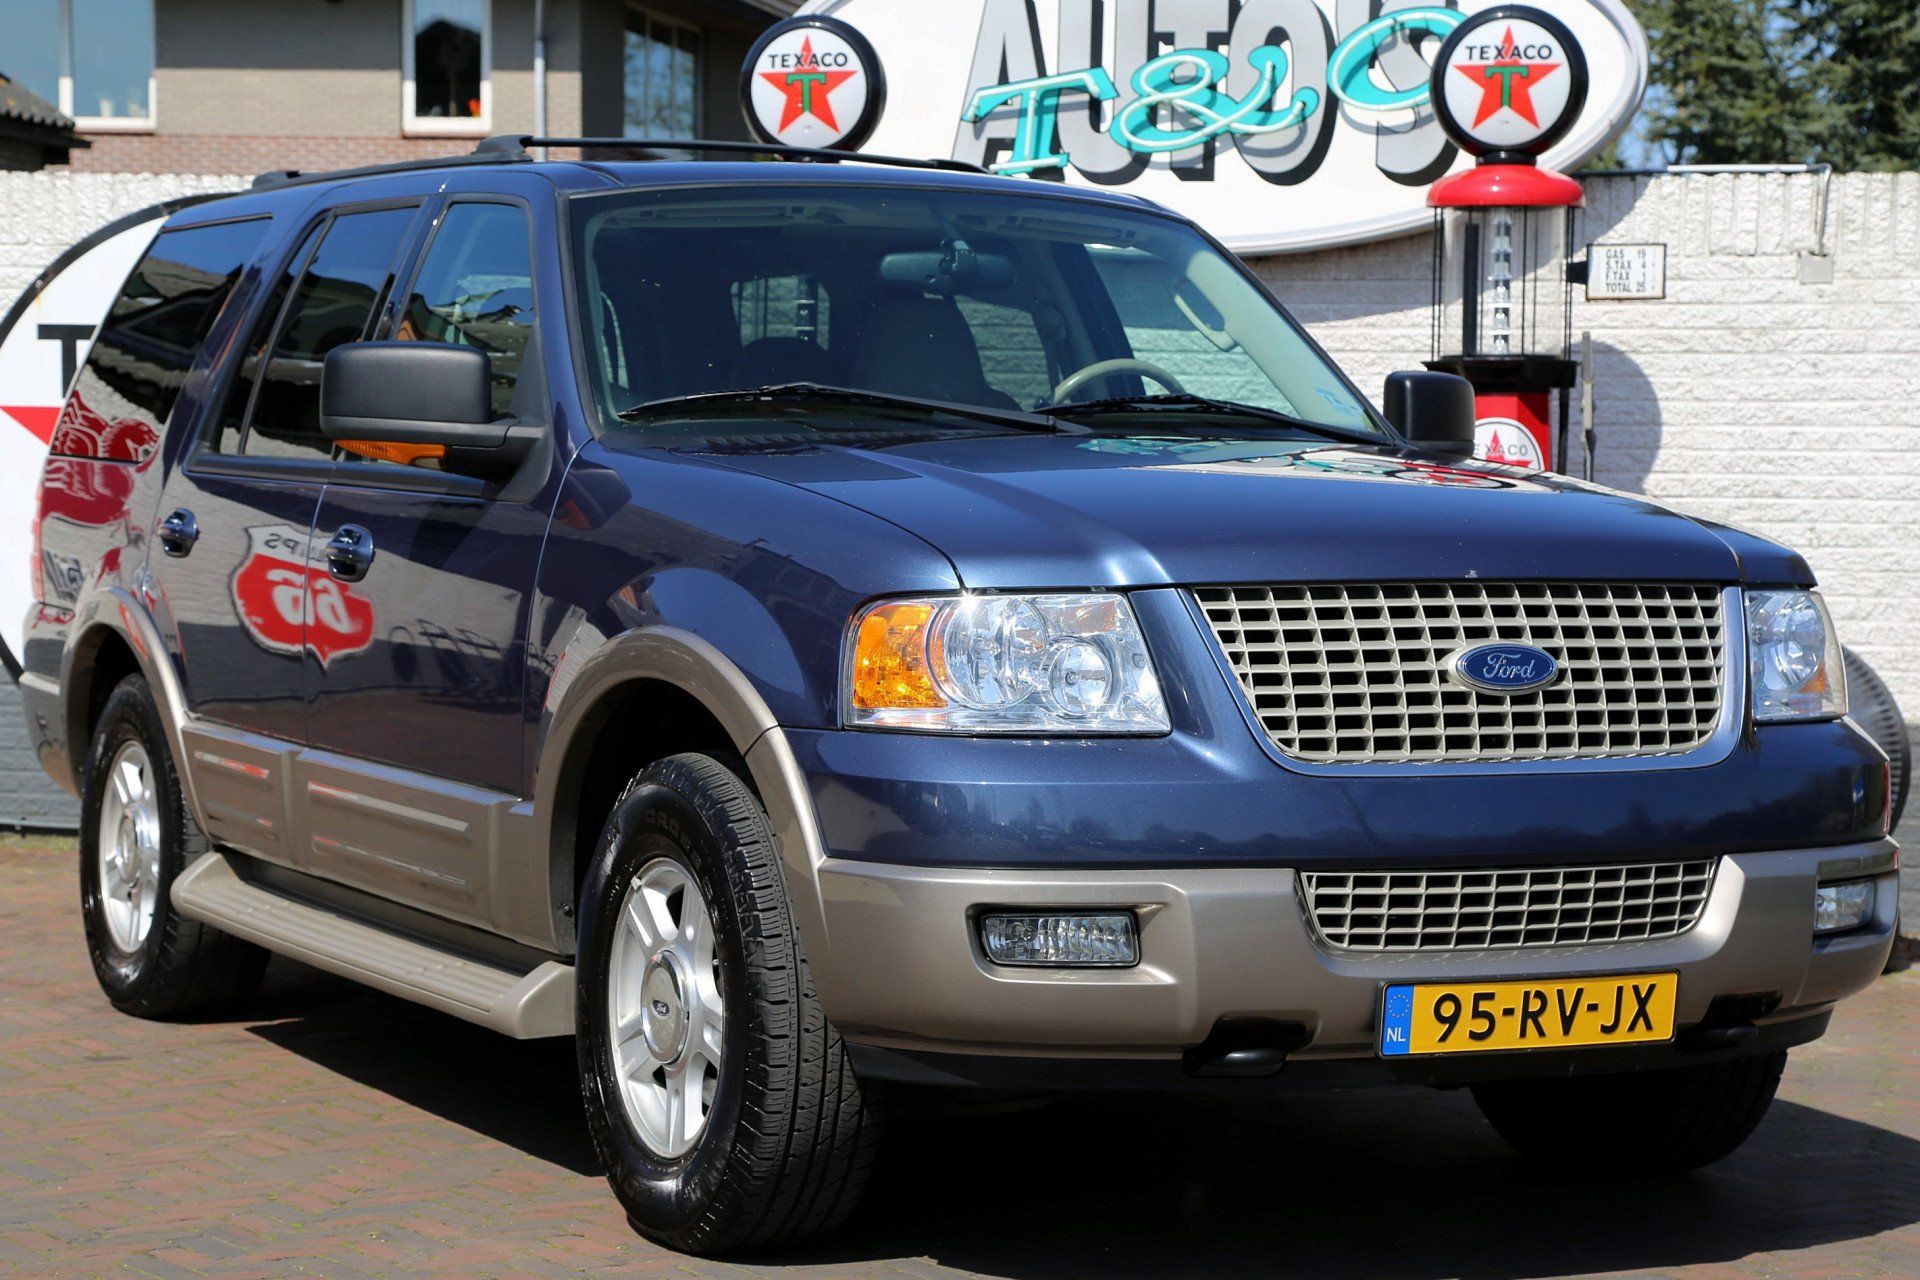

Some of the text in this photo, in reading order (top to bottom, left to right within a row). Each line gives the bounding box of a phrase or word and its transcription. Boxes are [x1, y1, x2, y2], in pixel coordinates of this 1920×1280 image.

[769, 52, 848, 68] TEXACO
[1465, 44, 1552, 60] TEXACO
[786, 73, 826, 113] T
[1484, 65, 1529, 107] T
[1606, 249, 1625, 259] GAS
[1615, 260, 1632, 270] TAX
[1606, 282, 1632, 293] TOTAL
[1483, 652, 1536, 679] Ford
[1433, 983, 1656, 1043] 95-RV-JX
[1386, 1027, 1406, 1043] NL
